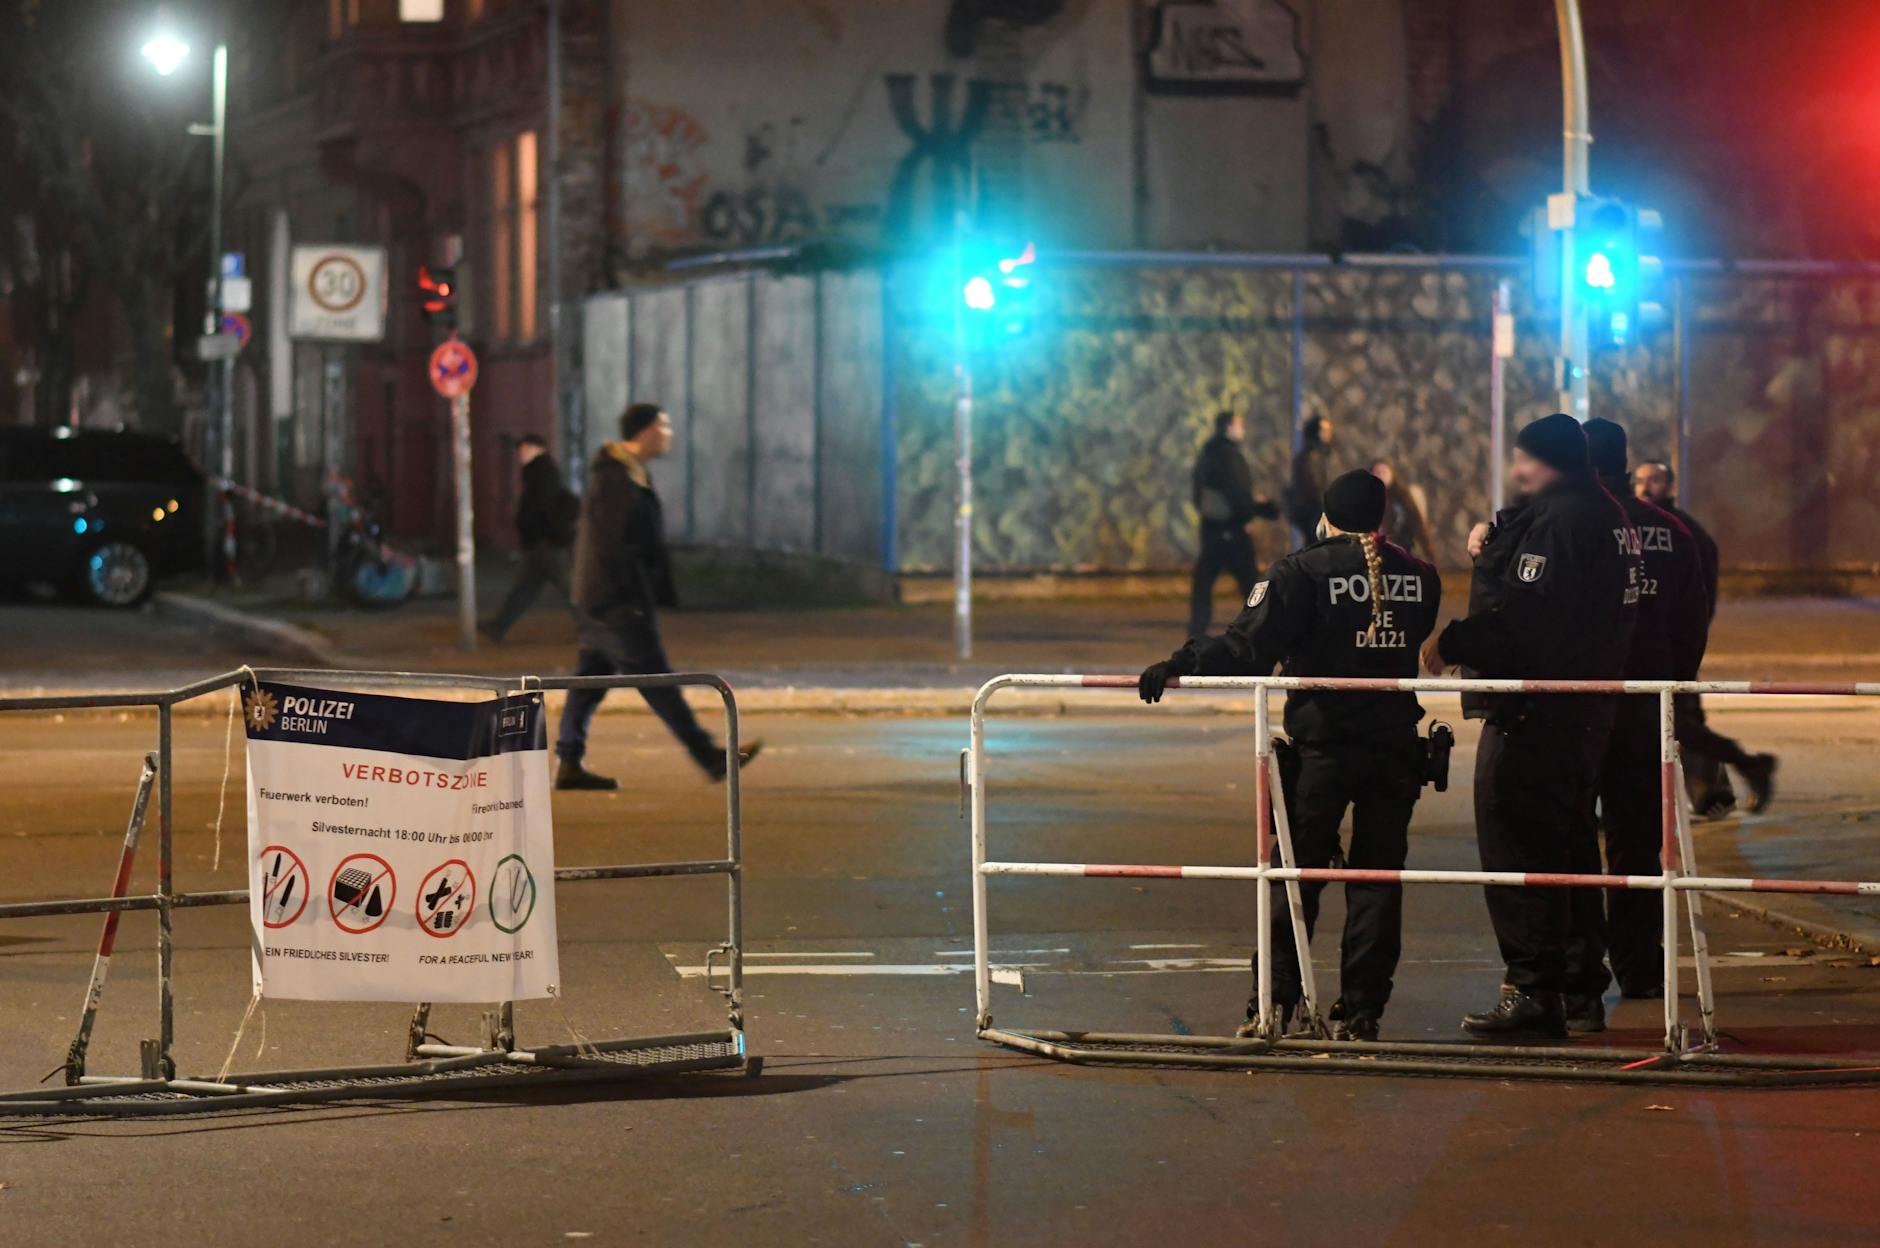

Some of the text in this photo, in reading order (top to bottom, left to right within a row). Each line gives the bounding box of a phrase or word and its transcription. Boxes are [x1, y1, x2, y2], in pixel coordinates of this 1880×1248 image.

[322, 268, 356, 298] 30
[1329, 574, 1423, 605] POIZEI
[283, 696, 355, 720] POLIZEI
[281, 716, 328, 734] BERLIN
[315, 795, 369, 808] verboten!
[312, 821, 391, 839] Silvesternacht
[395, 829, 425, 842] 18:00
[428, 834, 448, 845] Uhr
[265, 946, 281, 957] EIN
[339, 951, 389, 963] SILVESTER!
[419, 955, 439, 964] FOR
[440, 956, 446, 964] A
[448, 953, 489, 964] PEACEFUL
[492, 952, 511, 963] NEW
